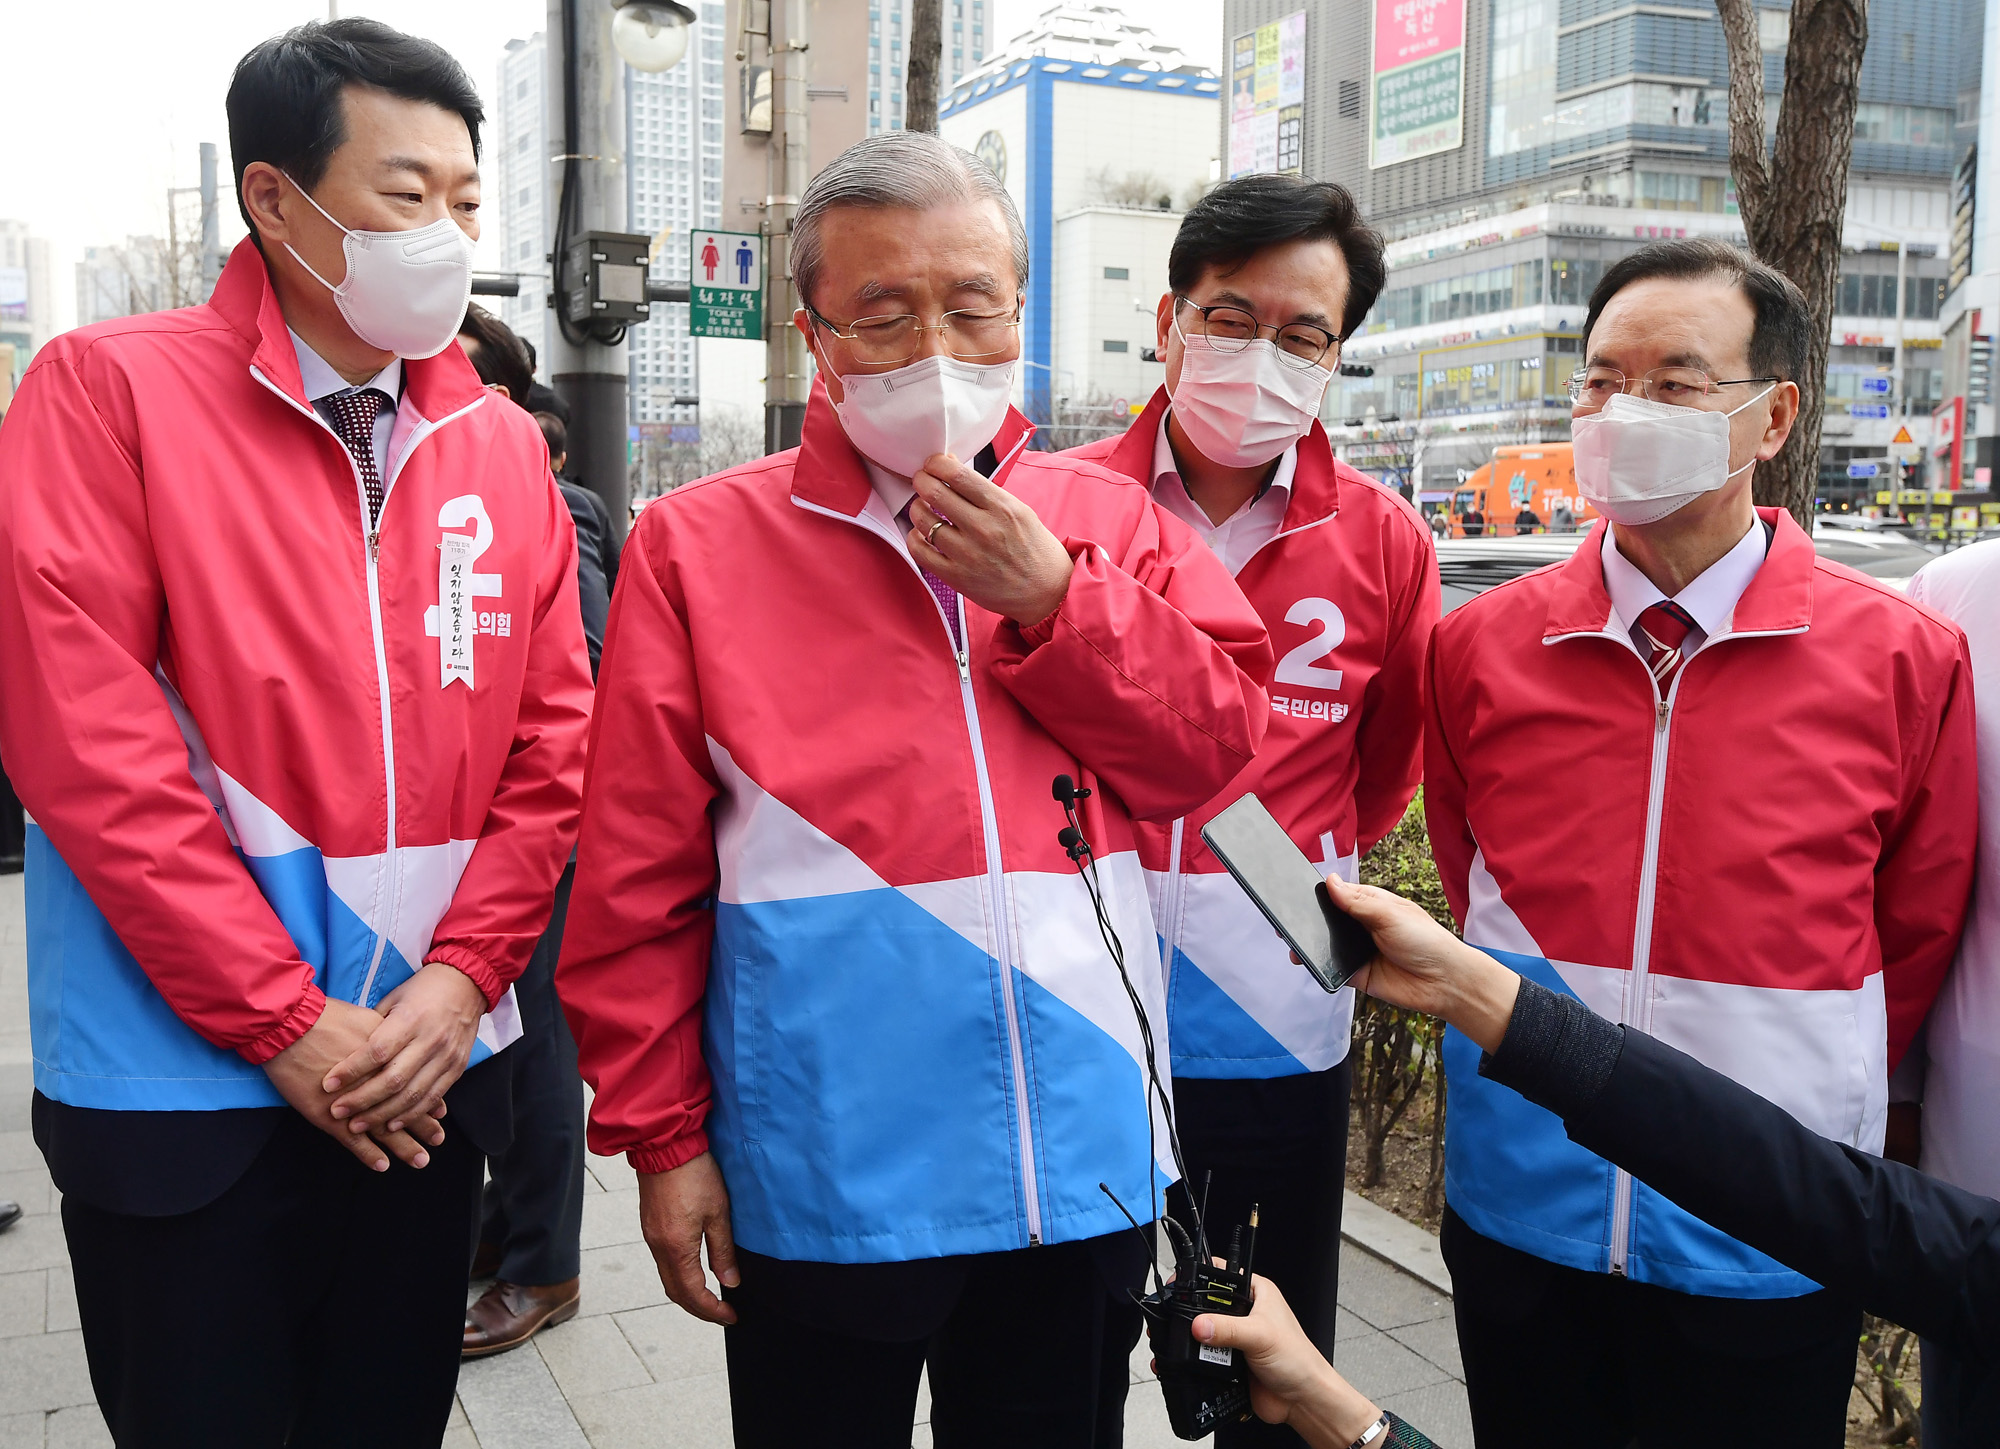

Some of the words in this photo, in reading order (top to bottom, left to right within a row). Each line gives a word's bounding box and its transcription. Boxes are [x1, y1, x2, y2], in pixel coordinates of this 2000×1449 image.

[708, 309, 744, 318] TOILET
[1274, 597, 1346, 691] 2
[1270, 695, 1349, 723] 국민의힘
